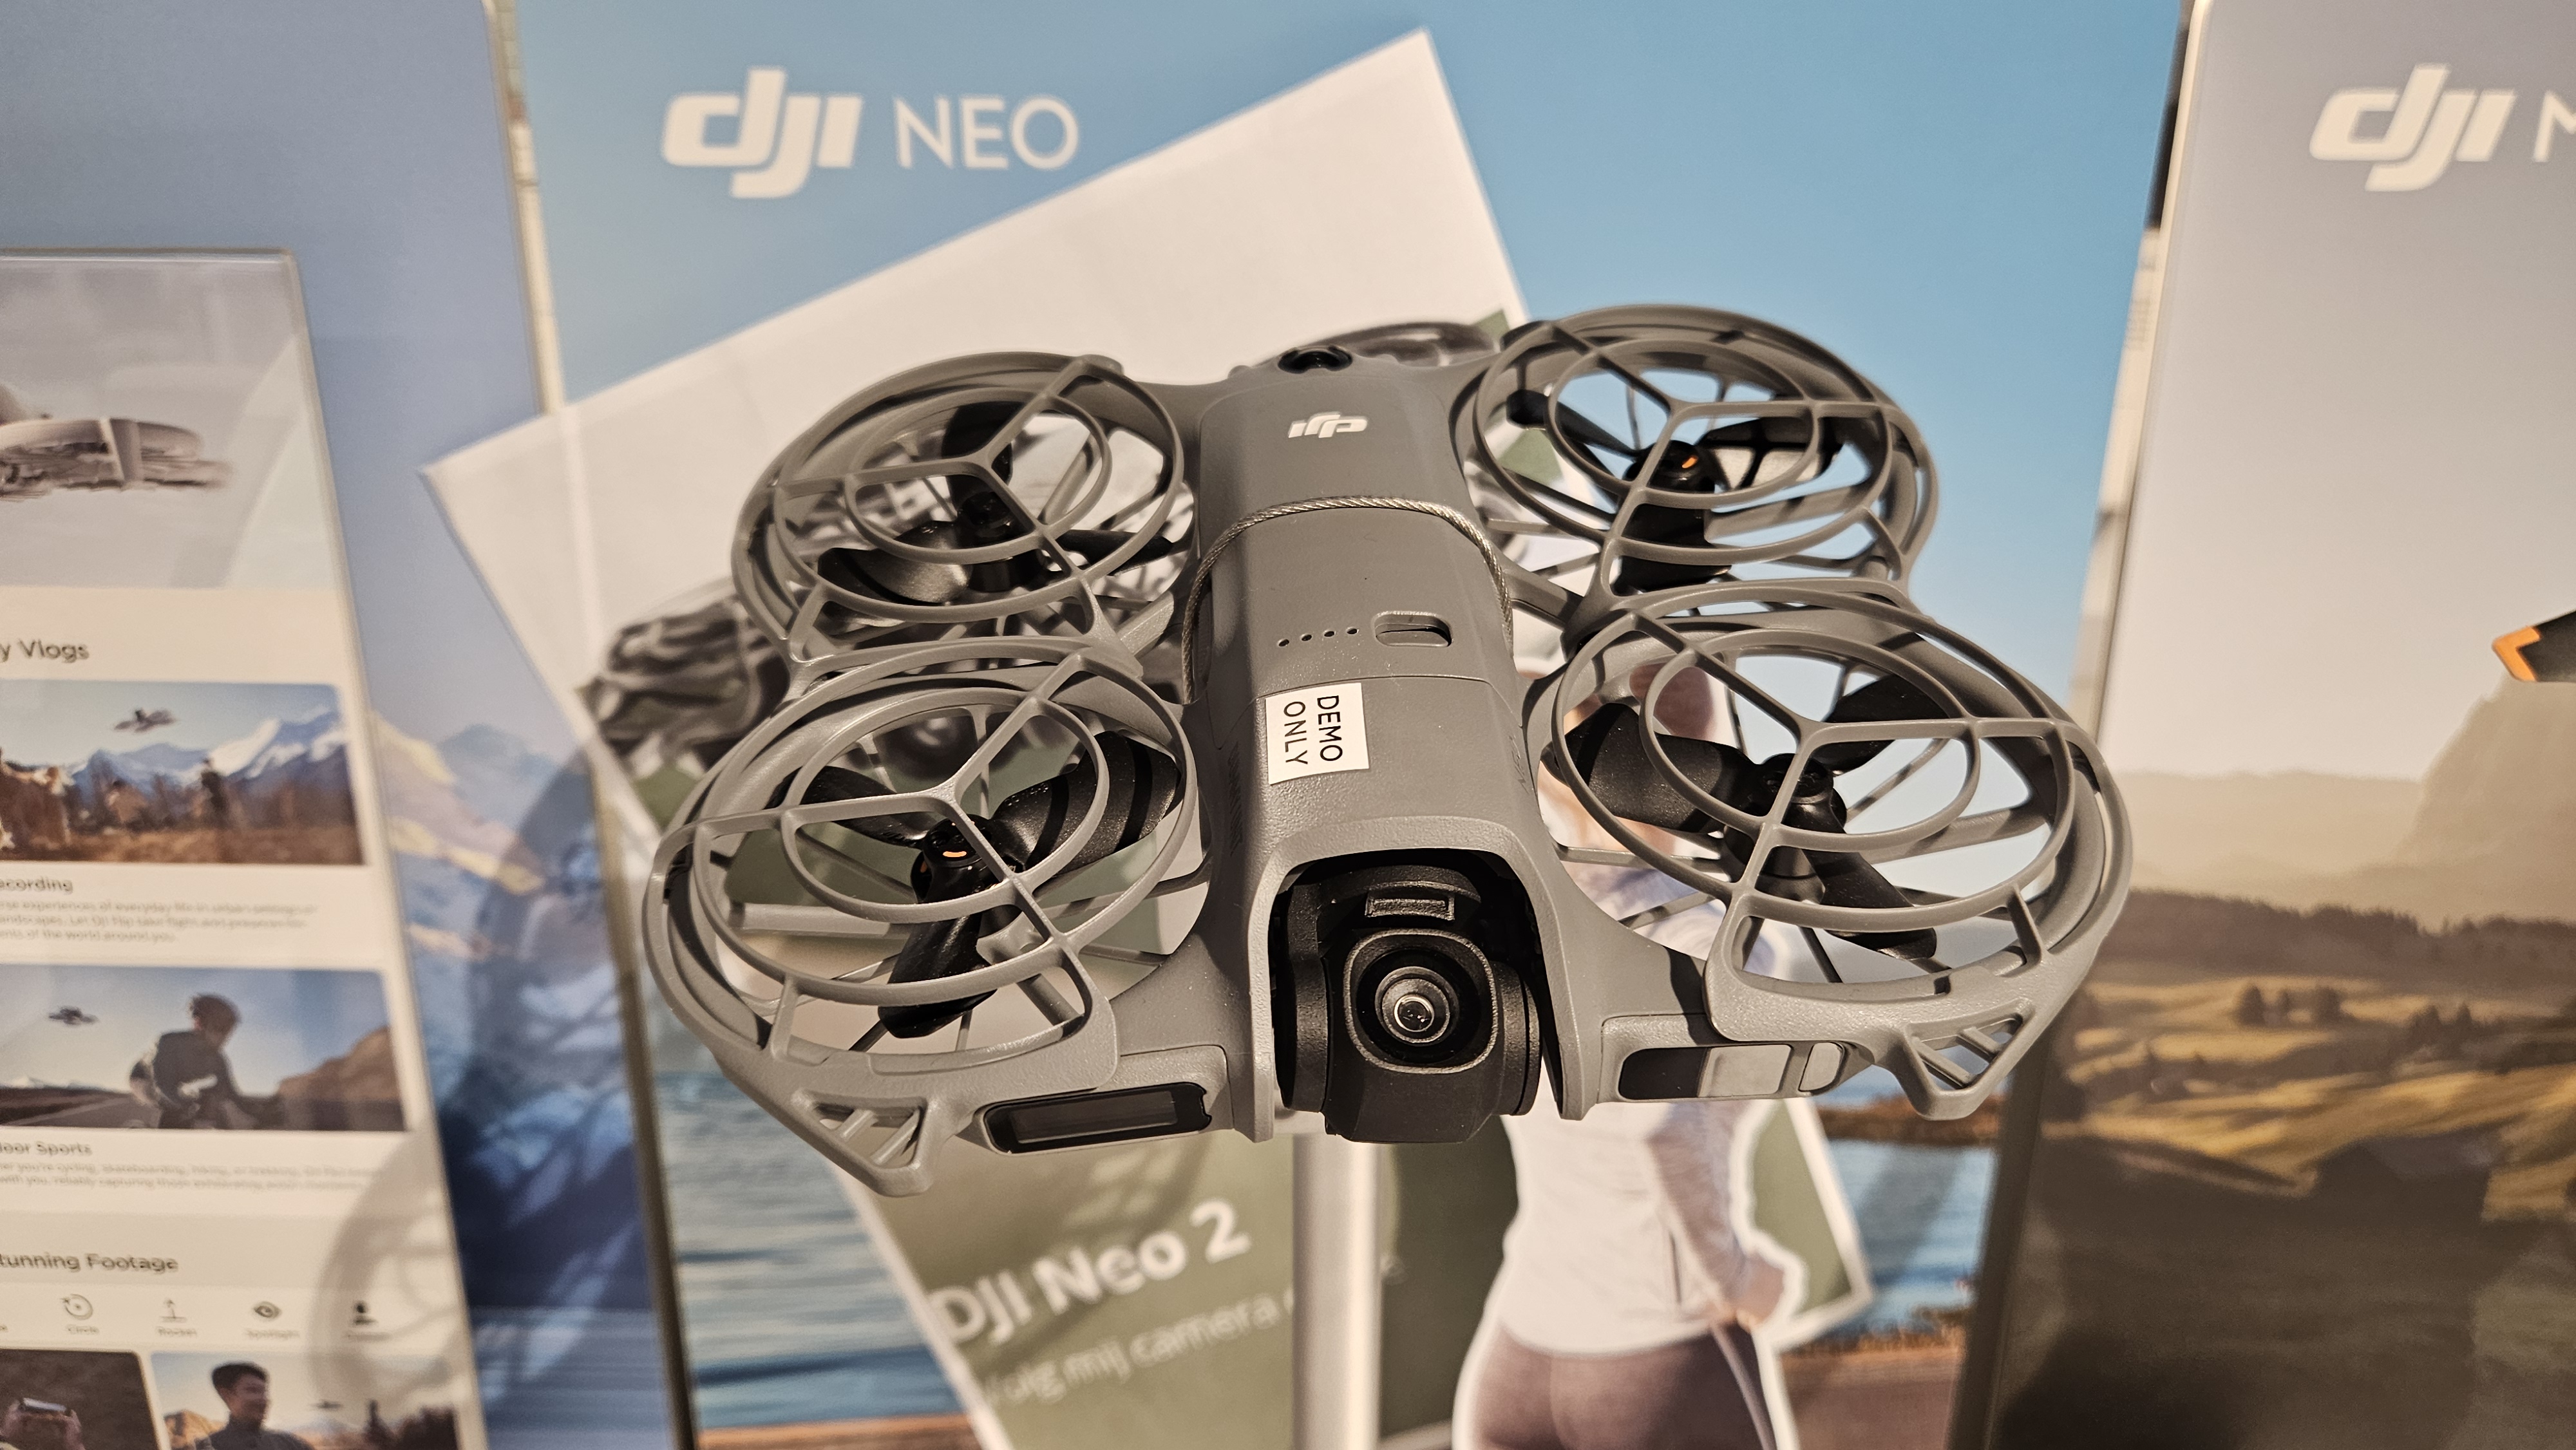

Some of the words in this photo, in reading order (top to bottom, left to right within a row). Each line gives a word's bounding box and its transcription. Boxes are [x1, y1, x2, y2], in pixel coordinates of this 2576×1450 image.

[893, 94, 1080, 170] NEO
[17, 638, 90, 664] Vlogs
[1283, 701, 1308, 765] ONLY
[1316, 695, 1343, 762] DEMO
[35, 1141, 93, 1157] Sports
[85, 1252, 179, 1275] Footage
[928, 1270, 1032, 1346] DJI
[1032, 1230, 1189, 1315] Neo
[1189, 1198, 1253, 1264] 2
[1129, 1290, 1282, 1368] camera
